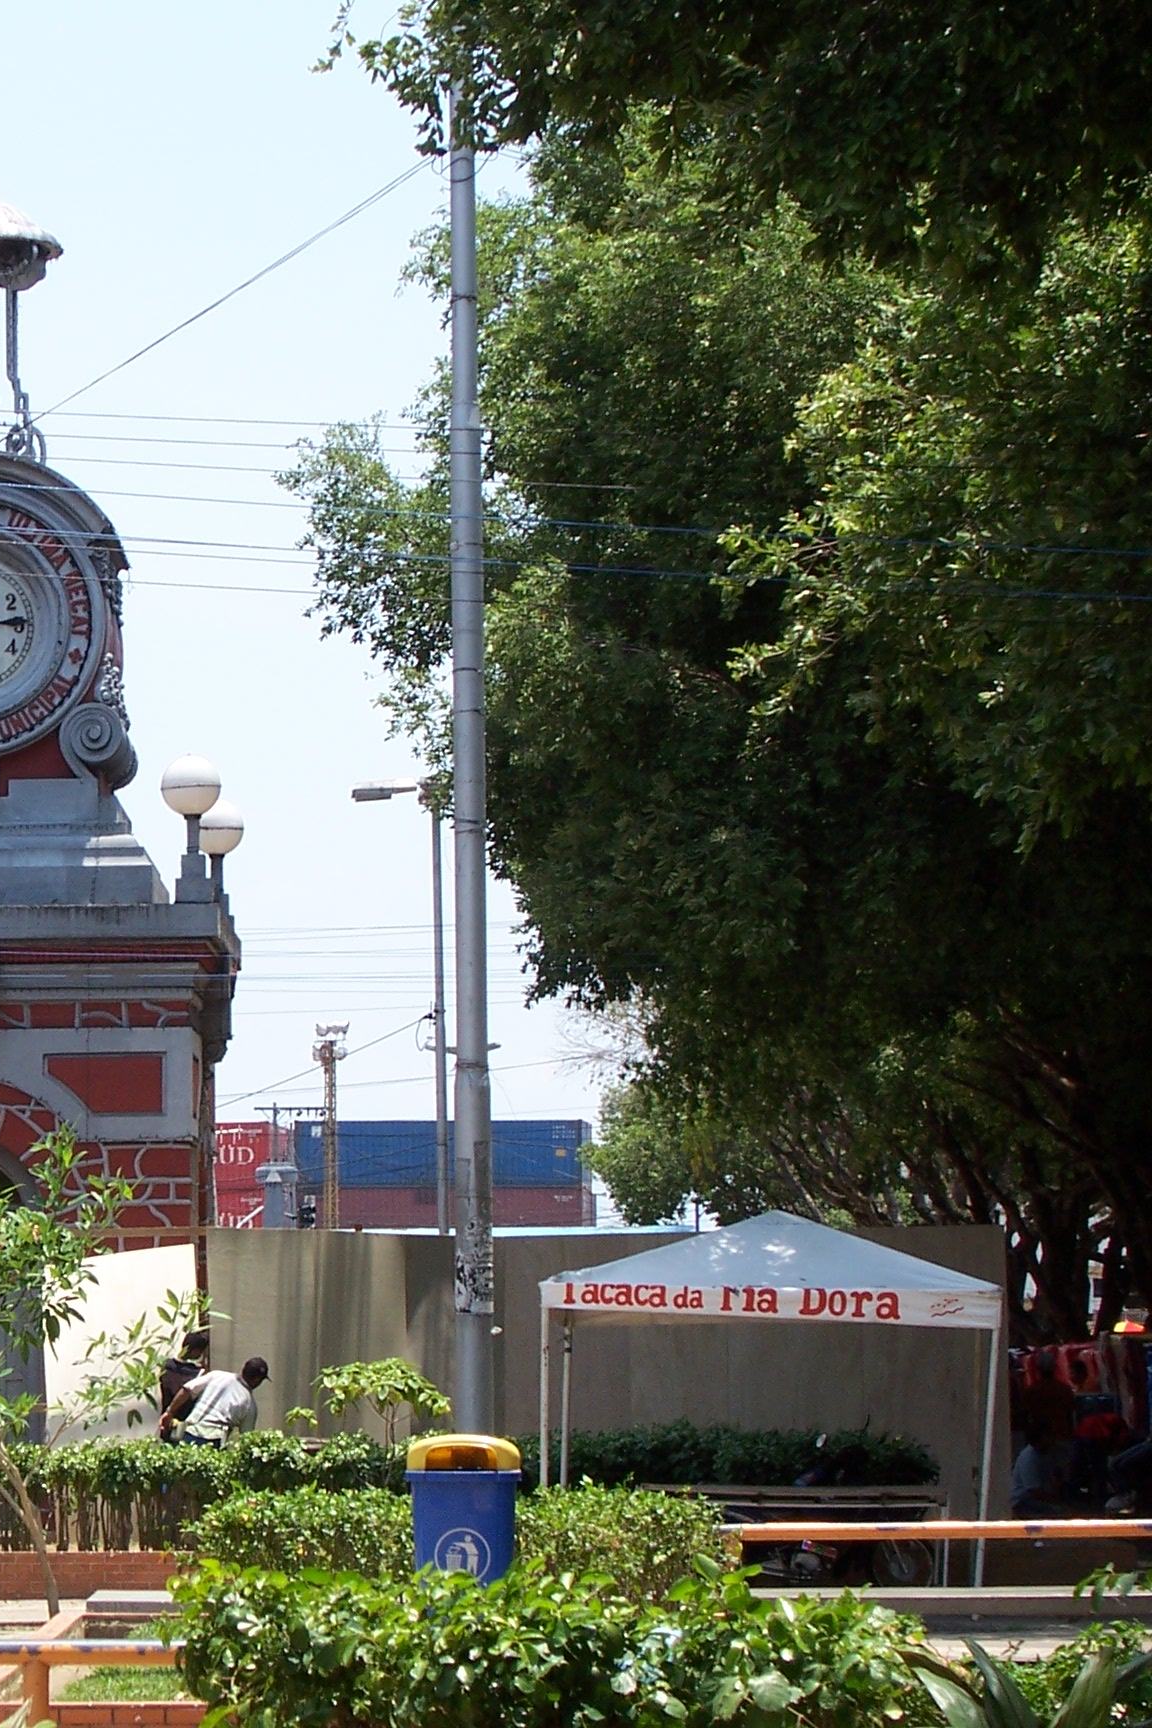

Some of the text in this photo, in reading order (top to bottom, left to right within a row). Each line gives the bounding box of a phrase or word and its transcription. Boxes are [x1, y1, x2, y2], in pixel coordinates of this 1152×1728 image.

[6, 593, 17, 610] 2
[64, 568, 91, 639] NECAT
[5, 638, 17, 656] 4
[673, 1286, 704, 1309] da
[799, 1287, 900, 1320] Dora
